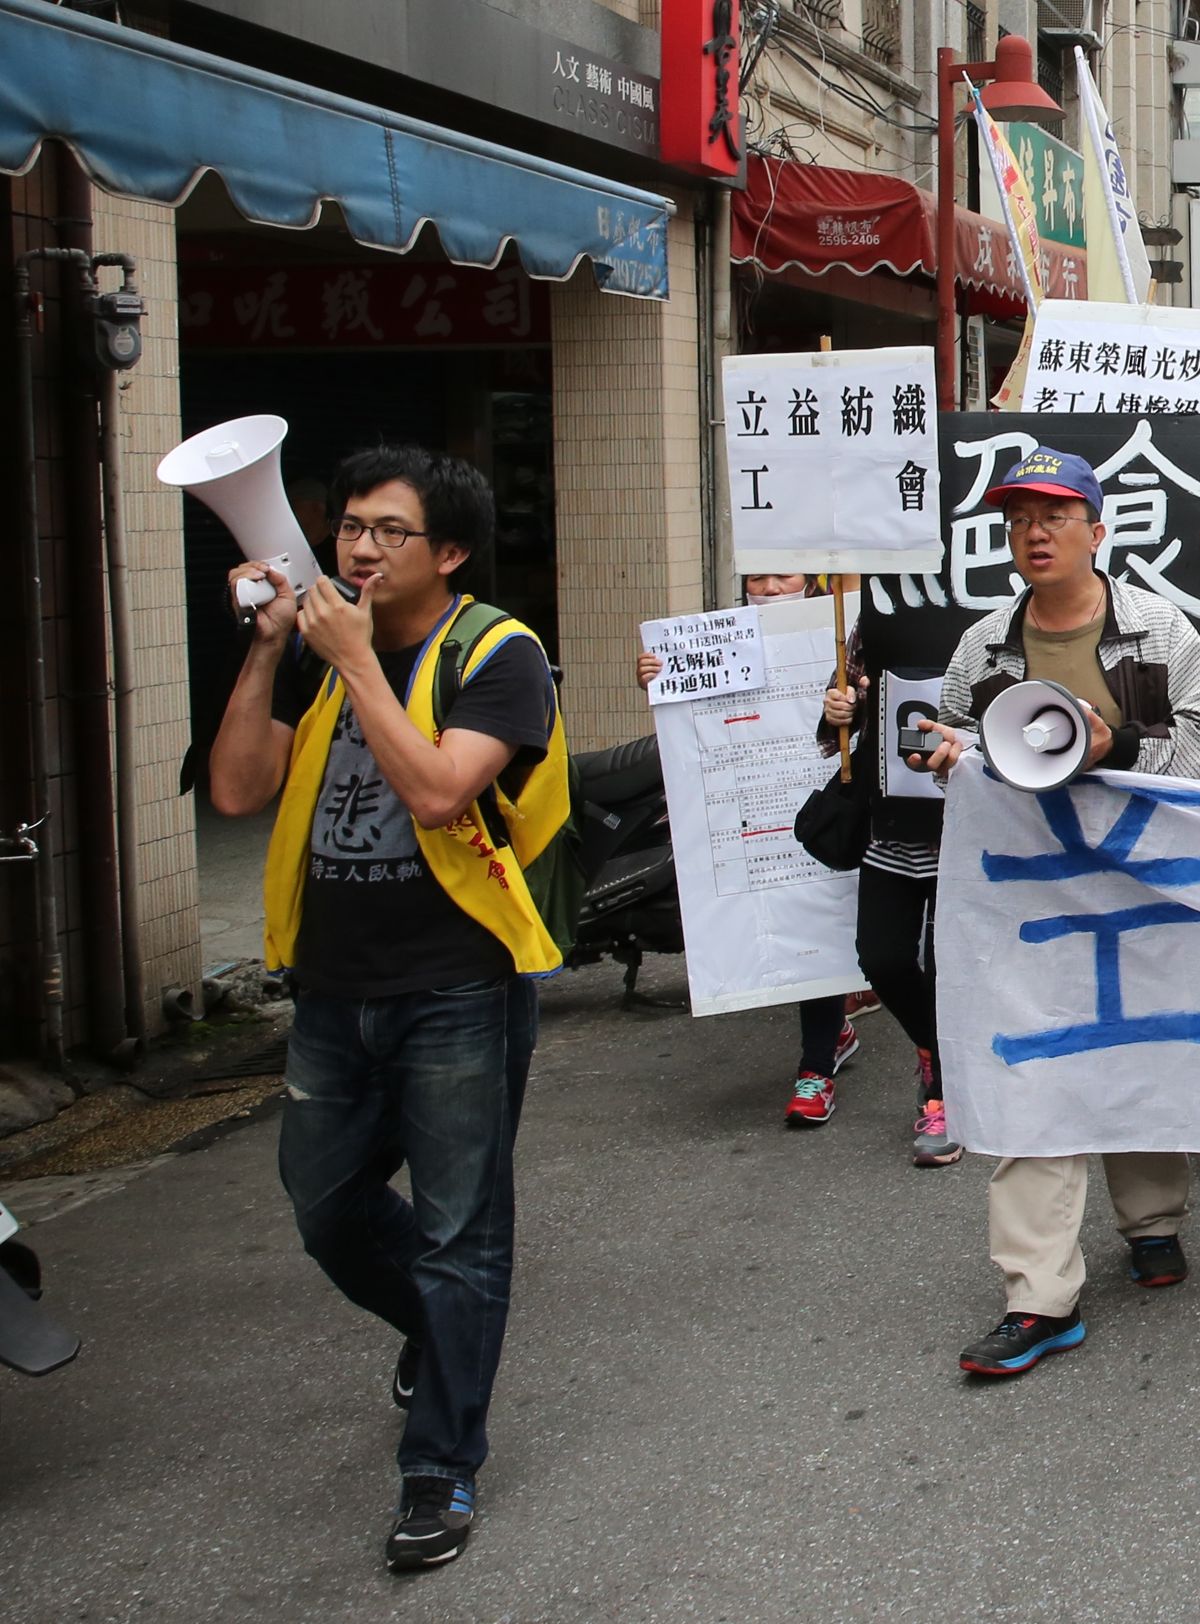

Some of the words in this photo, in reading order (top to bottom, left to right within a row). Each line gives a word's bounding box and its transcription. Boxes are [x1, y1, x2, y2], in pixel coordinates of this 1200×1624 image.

[552, 51, 580, 83] 人文
[617, 76, 655, 113] 中國風
[818, 234, 881, 246] 2596-2406
[737, 384, 927, 437] 立益紡織
